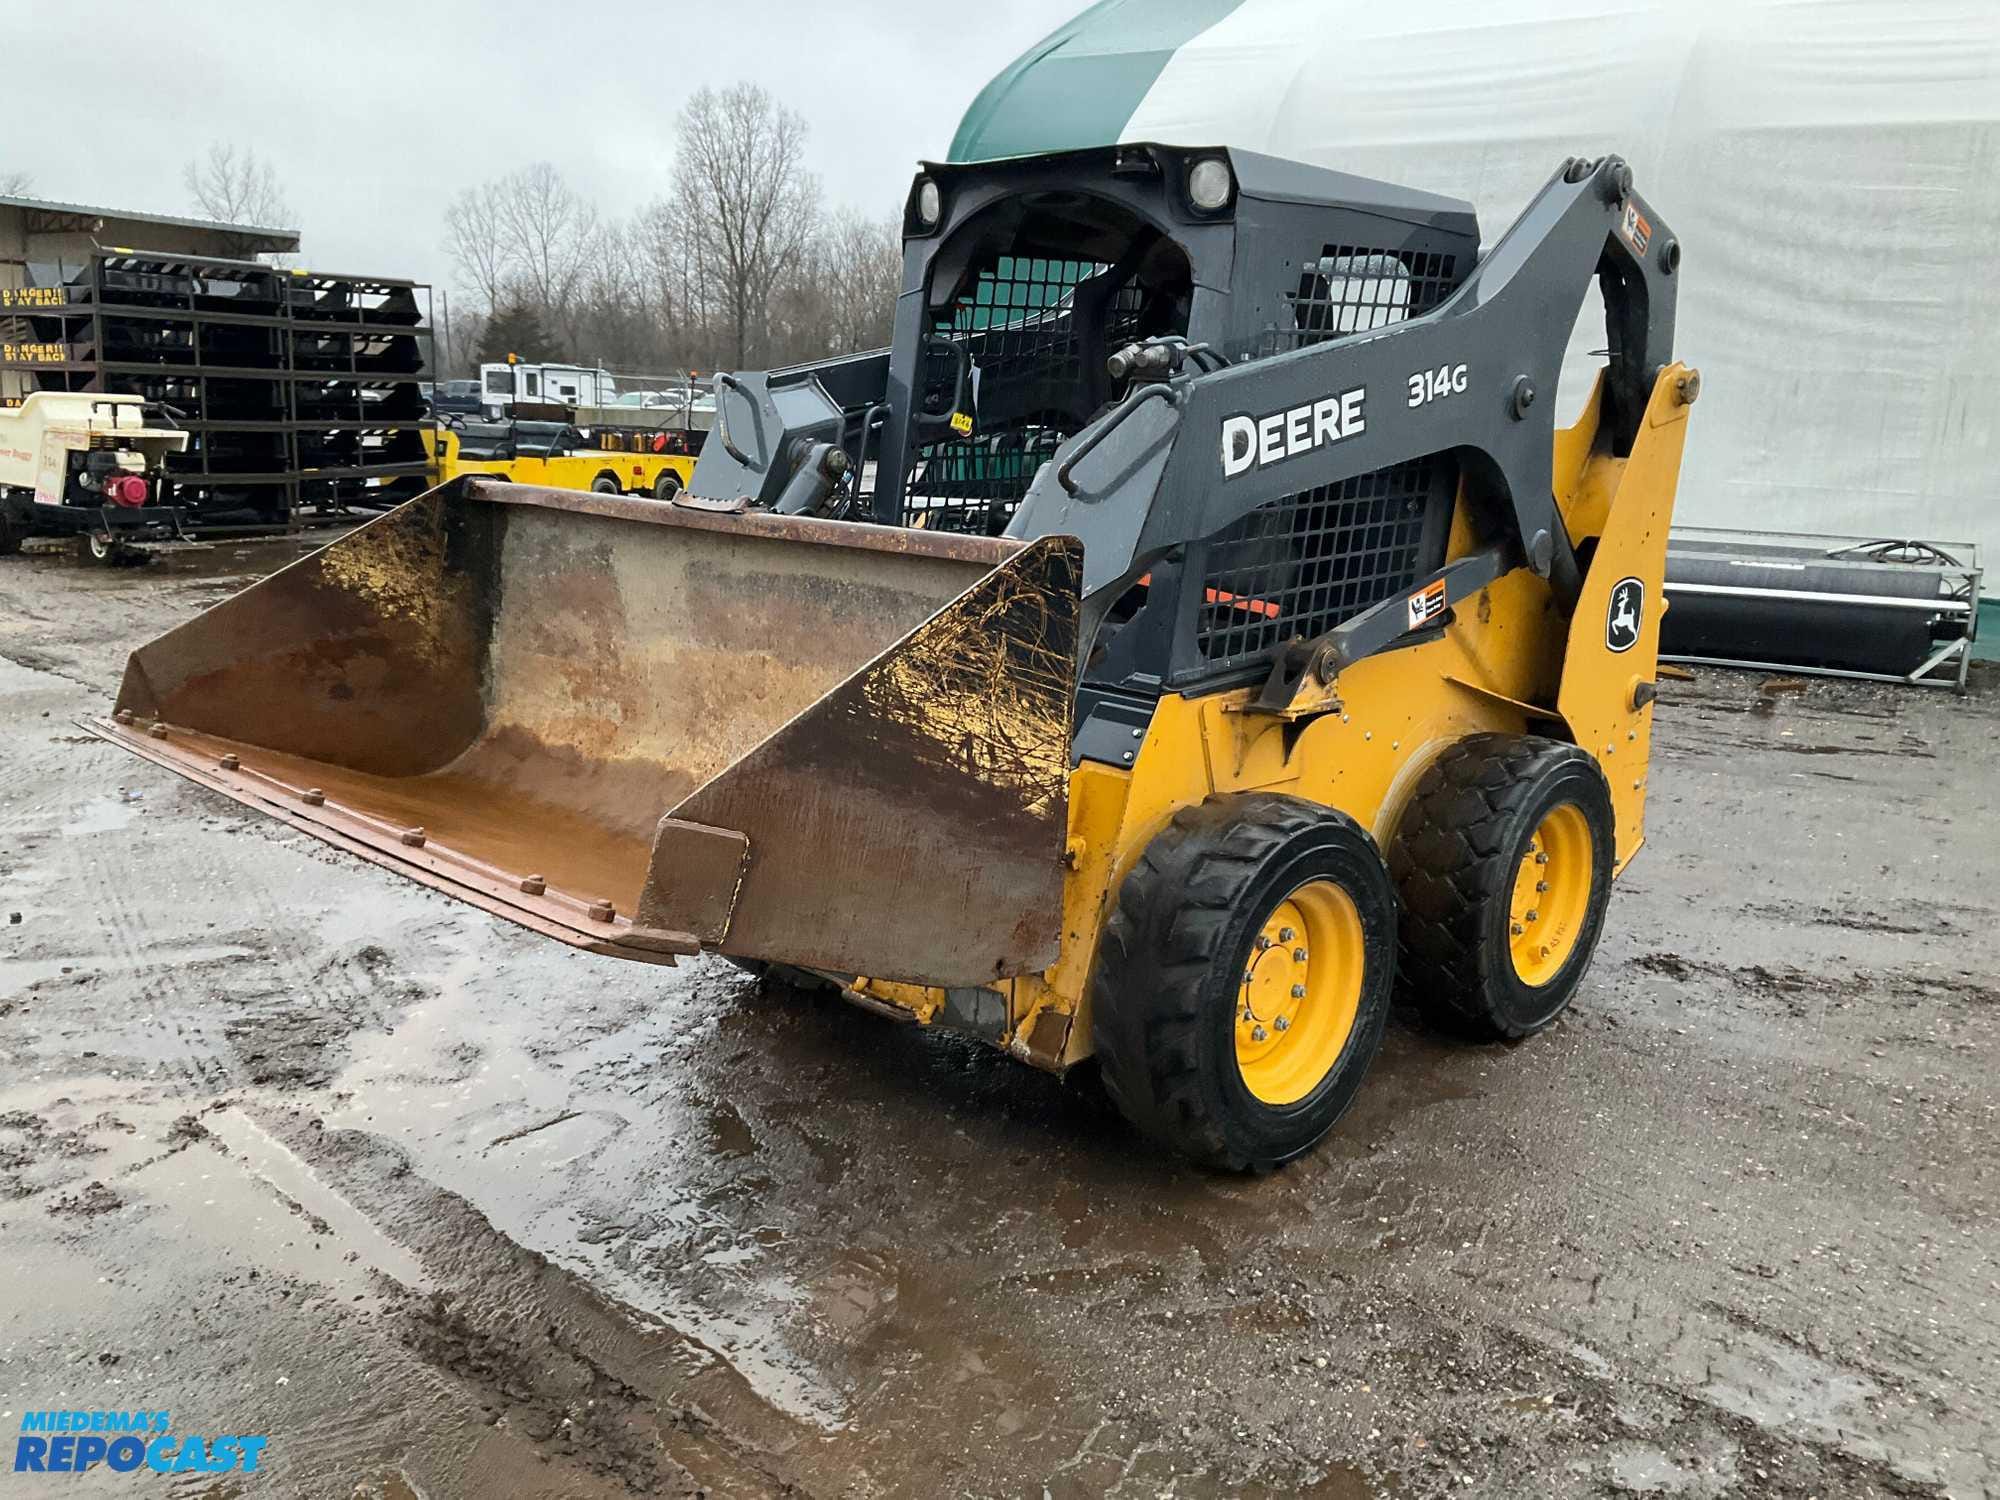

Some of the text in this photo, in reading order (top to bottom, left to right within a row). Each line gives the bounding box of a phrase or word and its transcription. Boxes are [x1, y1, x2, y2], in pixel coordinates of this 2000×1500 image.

[3, 297, 31, 306] SAY
[1408, 363, 1468, 408] 314G
[1221, 388, 1366, 477] DEERE
